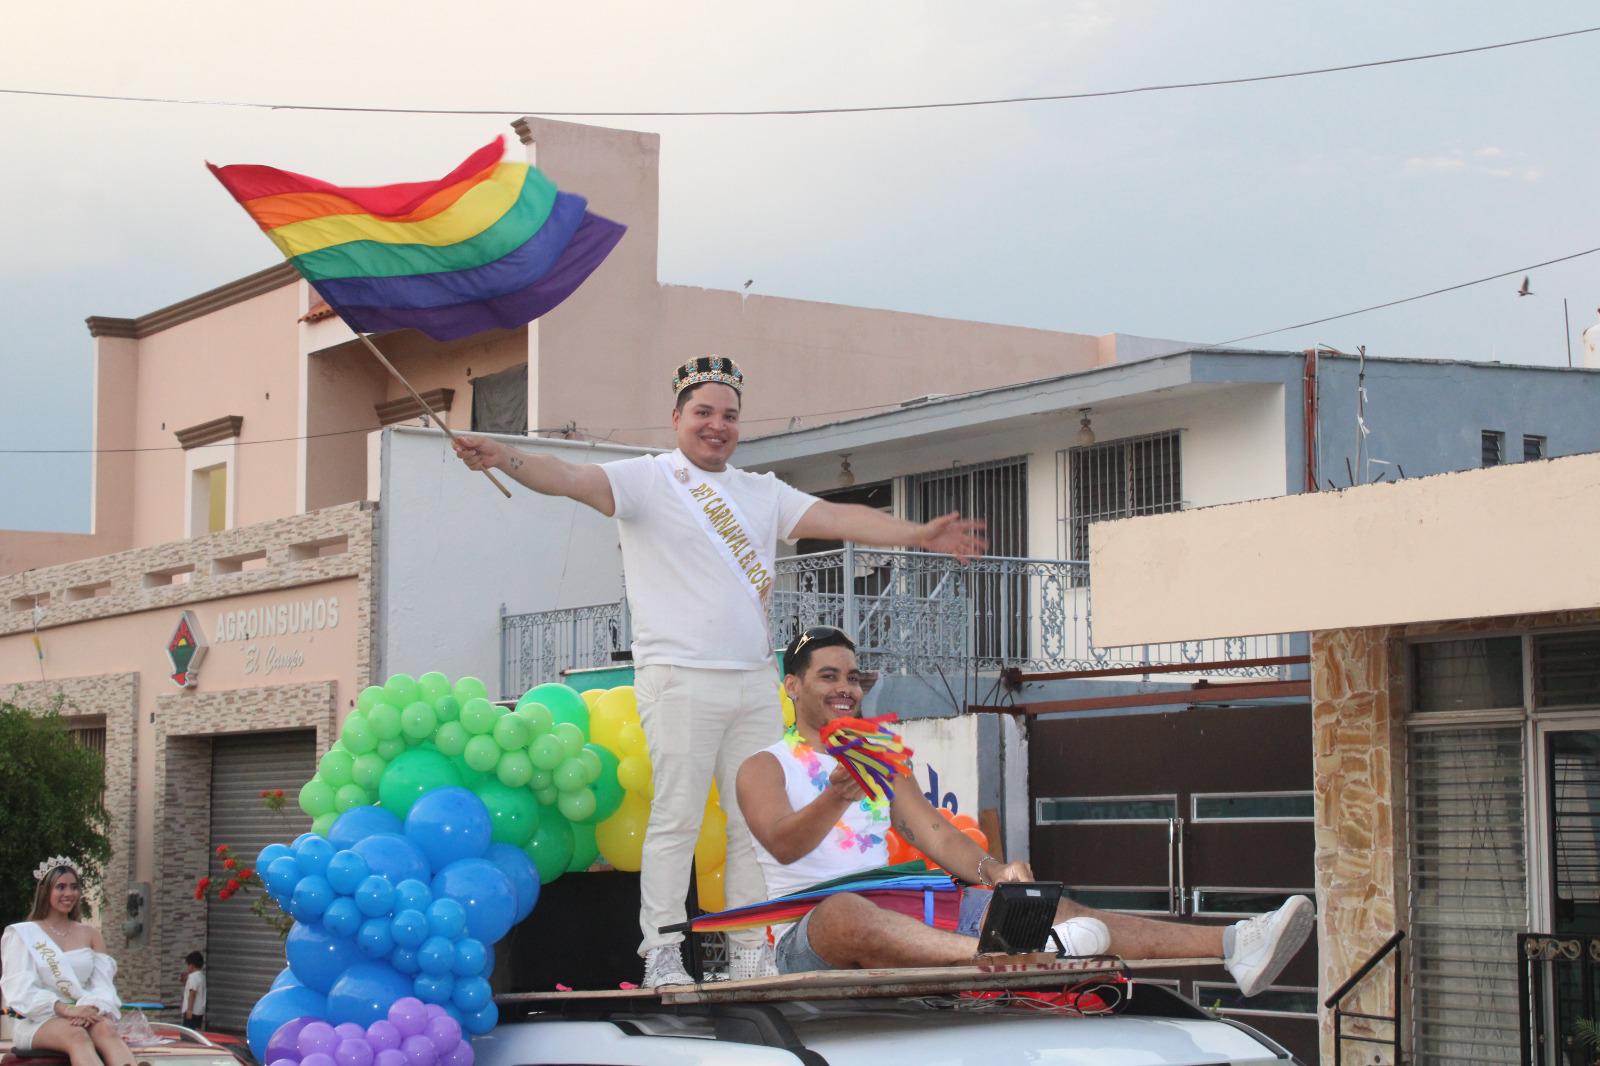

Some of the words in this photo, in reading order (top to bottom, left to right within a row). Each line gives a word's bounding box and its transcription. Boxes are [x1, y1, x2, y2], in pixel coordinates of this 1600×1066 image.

[689, 483, 717, 502] REY
[703, 498, 751, 558] CARNAVAL
[738, 550, 756, 570] EL
[215, 597, 339, 643] AGROINSUMOS
[245, 645, 260, 674] El
[265, 644, 304, 675] Campo
